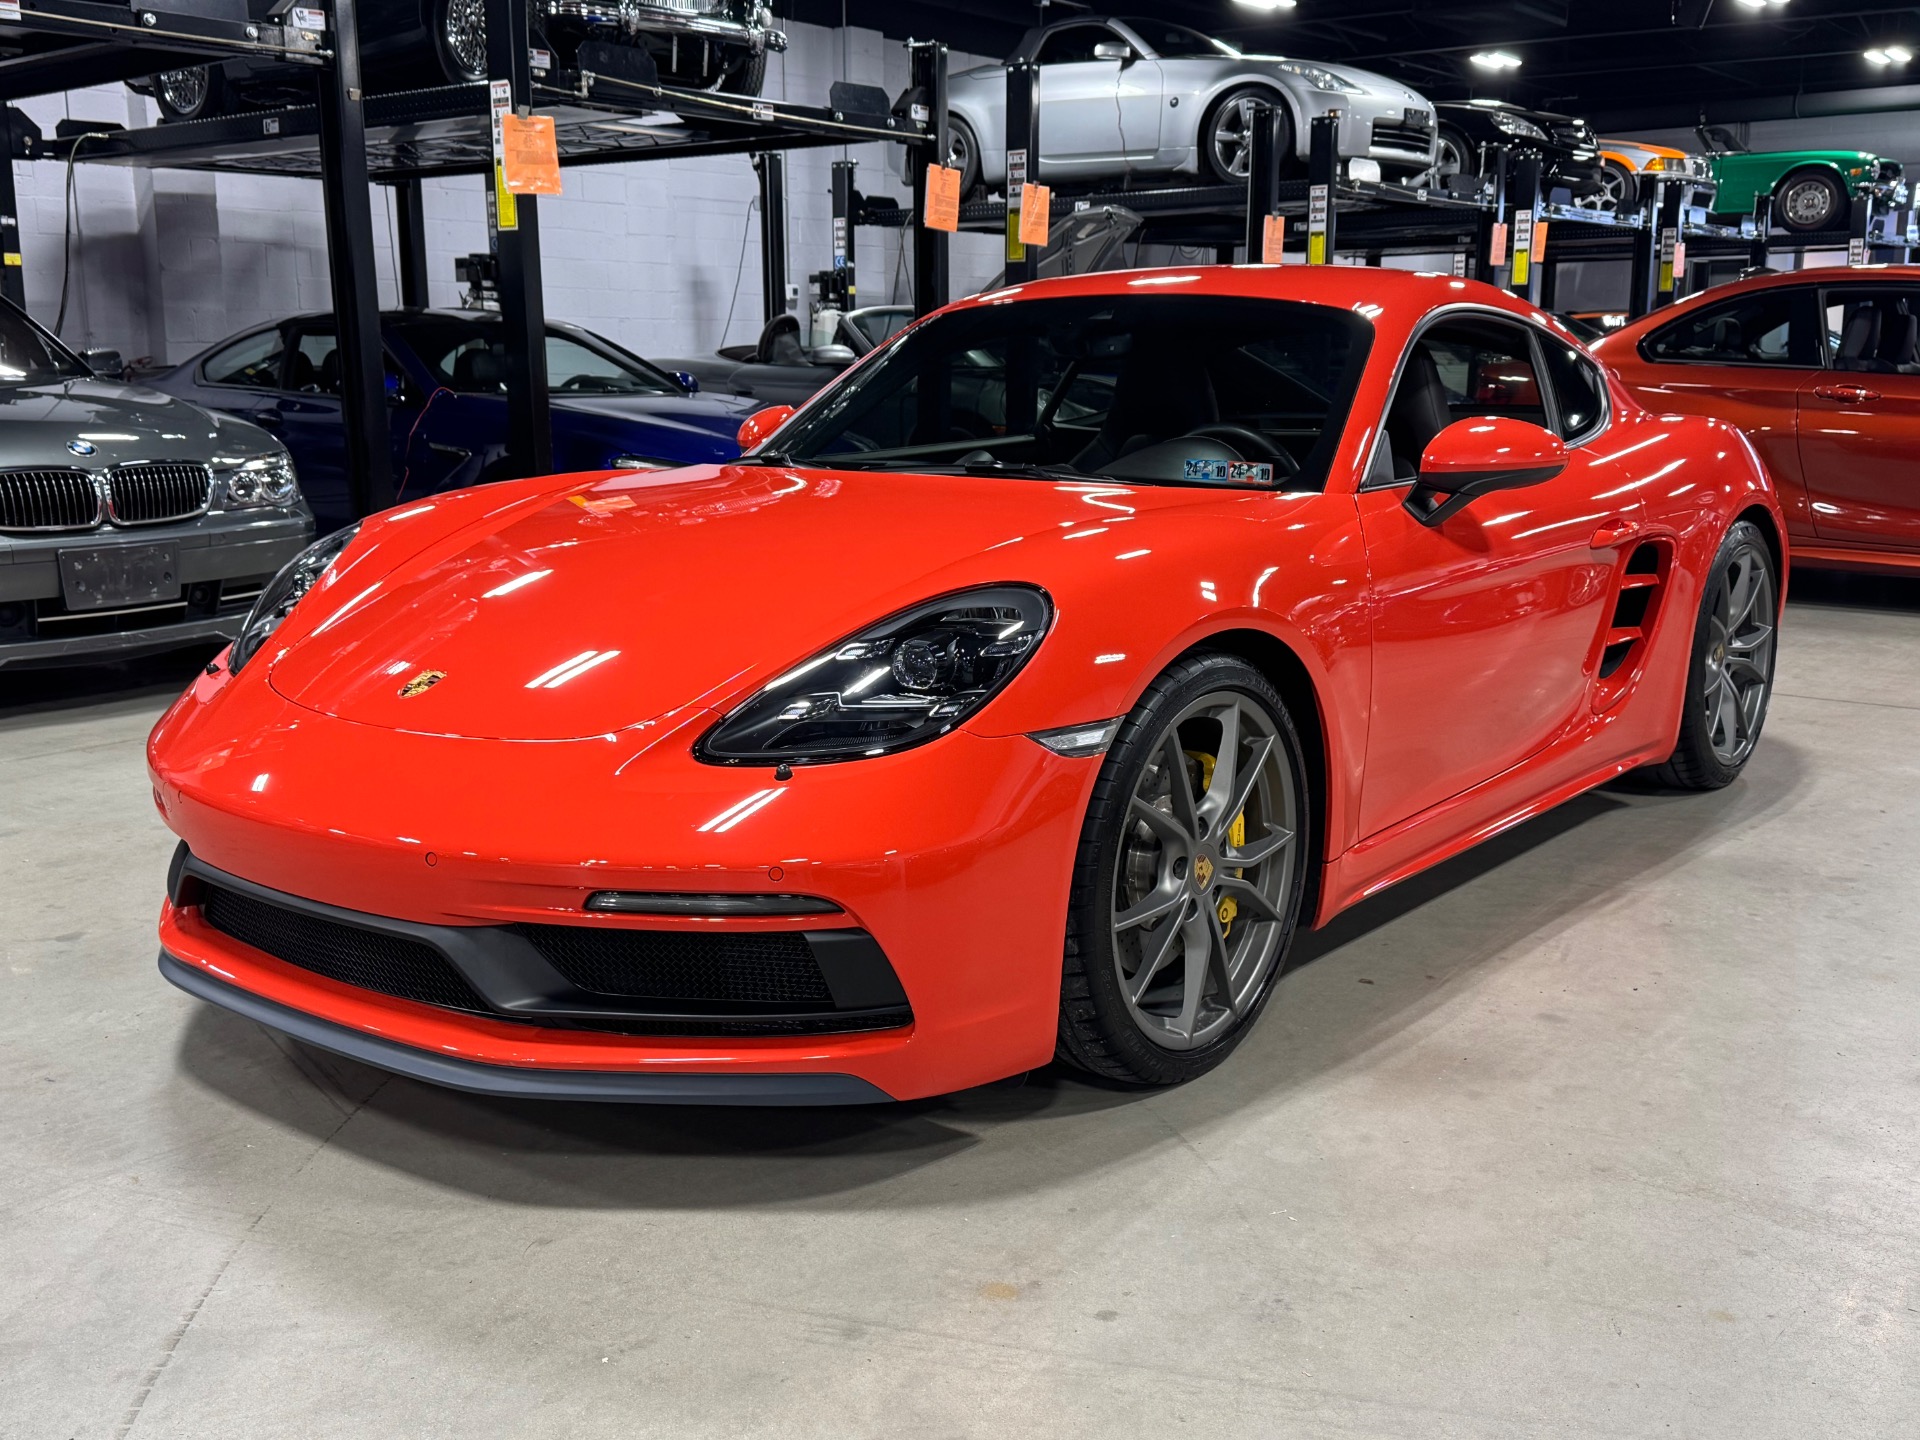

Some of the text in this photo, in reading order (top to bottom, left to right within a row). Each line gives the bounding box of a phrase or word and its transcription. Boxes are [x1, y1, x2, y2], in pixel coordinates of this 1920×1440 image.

[1187, 462, 1226, 478] 24 10
[1231, 463, 1242, 478] 24
